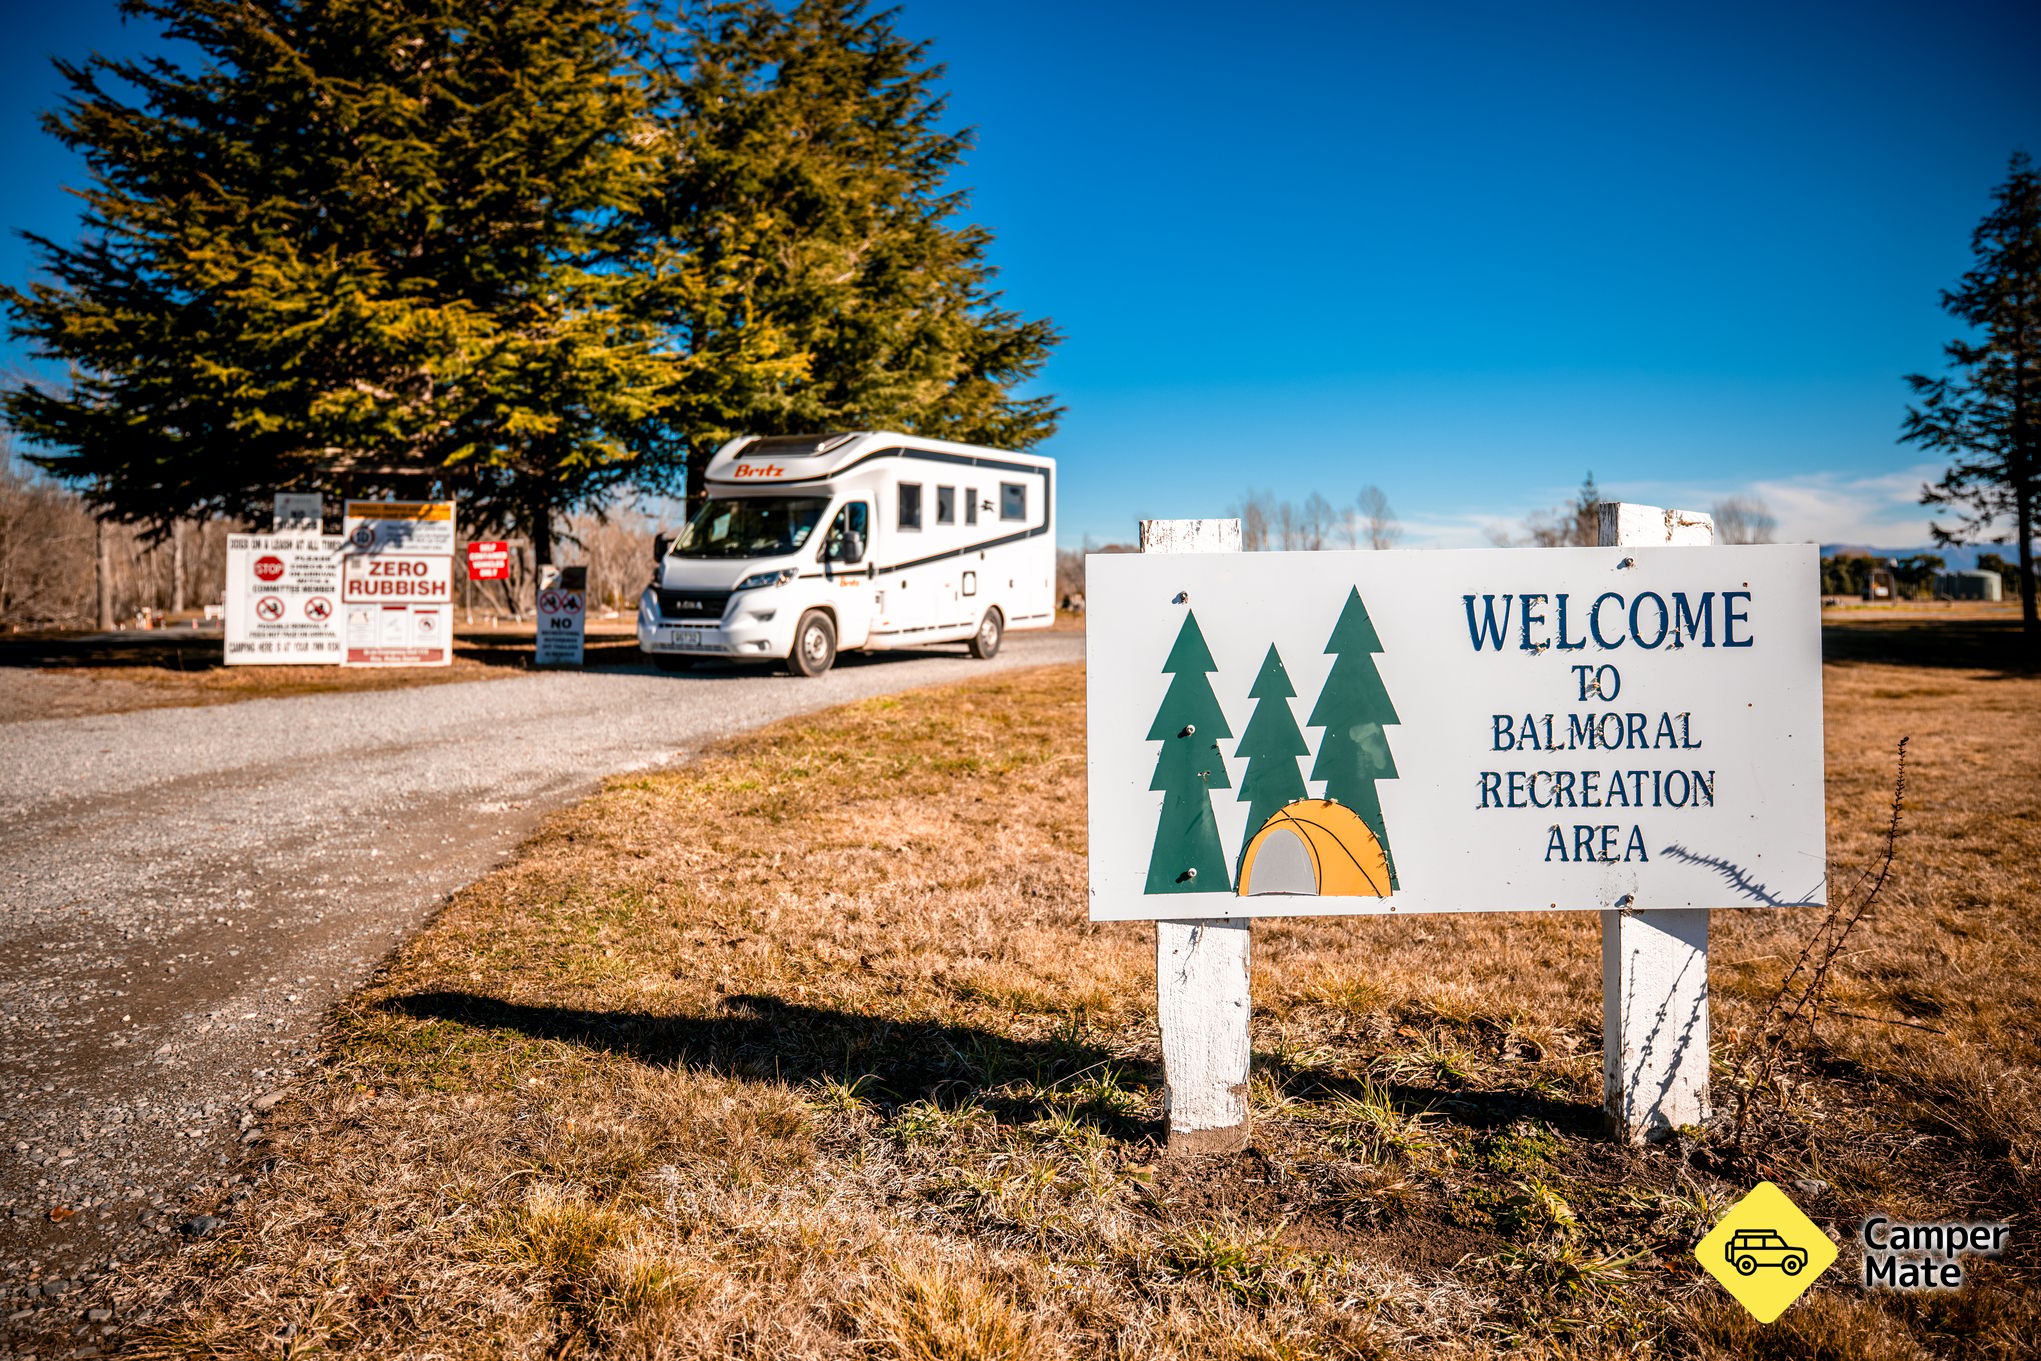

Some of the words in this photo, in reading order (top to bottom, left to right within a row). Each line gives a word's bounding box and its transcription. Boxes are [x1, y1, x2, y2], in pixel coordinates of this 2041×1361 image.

[734, 463, 784, 478] Britz
[255, 563, 282, 575] STOP
[369, 560, 427, 577] ZERO
[348, 580, 446, 595] RUBBISH
[550, 617, 573, 629] NO
[1461, 591, 1754, 651] WELCOME
[1571, 664, 1621, 702] TO
[1490, 712, 1702, 751] BALMORAL
[1478, 770, 1716, 809] RECREATION
[1544, 824, 1649, 863] AREA
